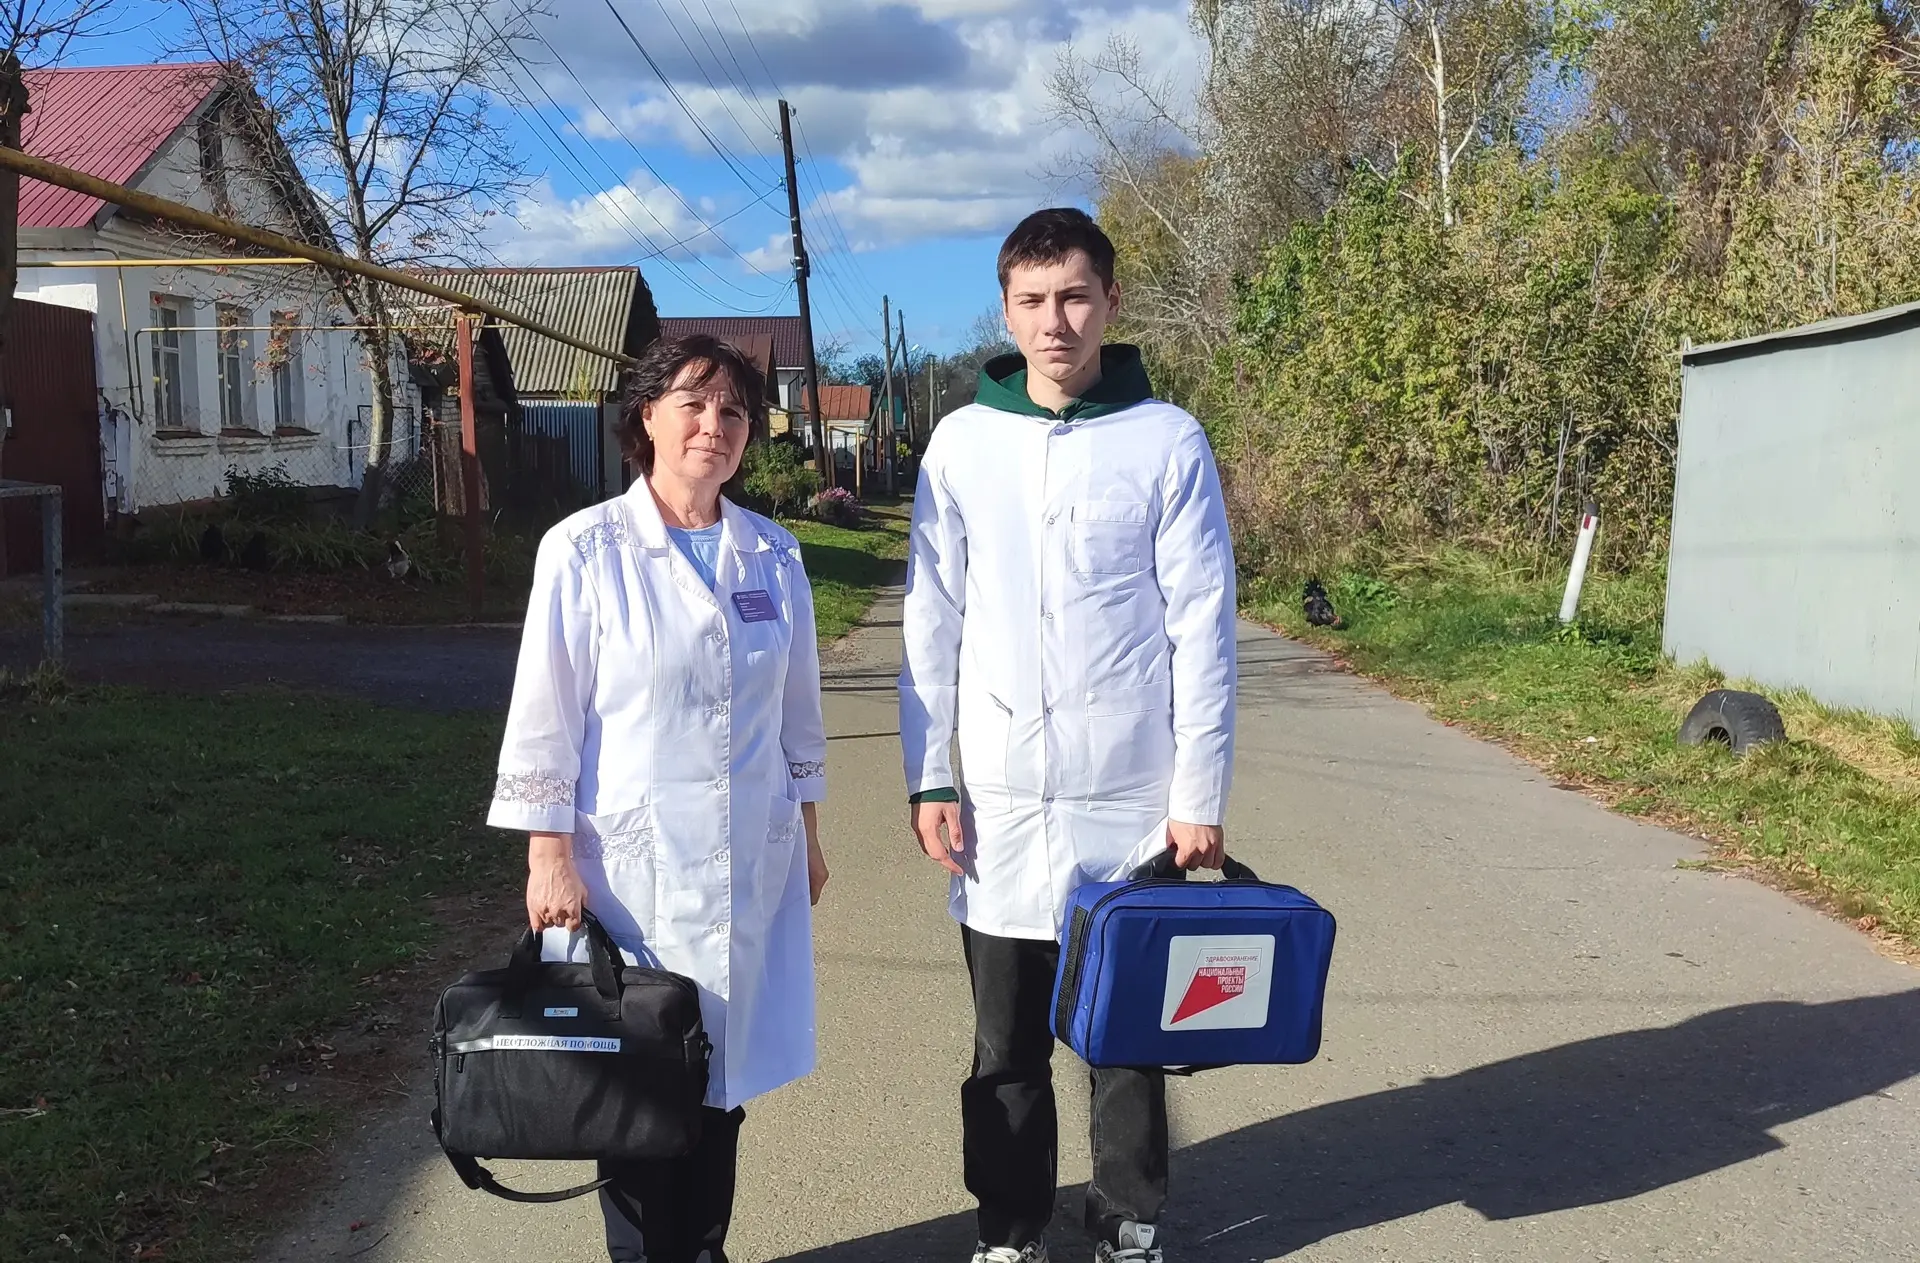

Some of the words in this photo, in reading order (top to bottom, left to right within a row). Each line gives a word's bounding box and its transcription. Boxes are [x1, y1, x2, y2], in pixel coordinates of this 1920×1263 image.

[1205, 955, 1259, 963] ЗДРАВООХРАНЕНИЕ
[1198, 967, 1245, 977] НАЦИОНАЛЬНЫЕ
[1217, 976, 1244, 985] ПРОЕКТЫ
[1221, 984, 1243, 993] РОССИИ
[570, 1040, 617, 1051] ПОМОЩЬ
